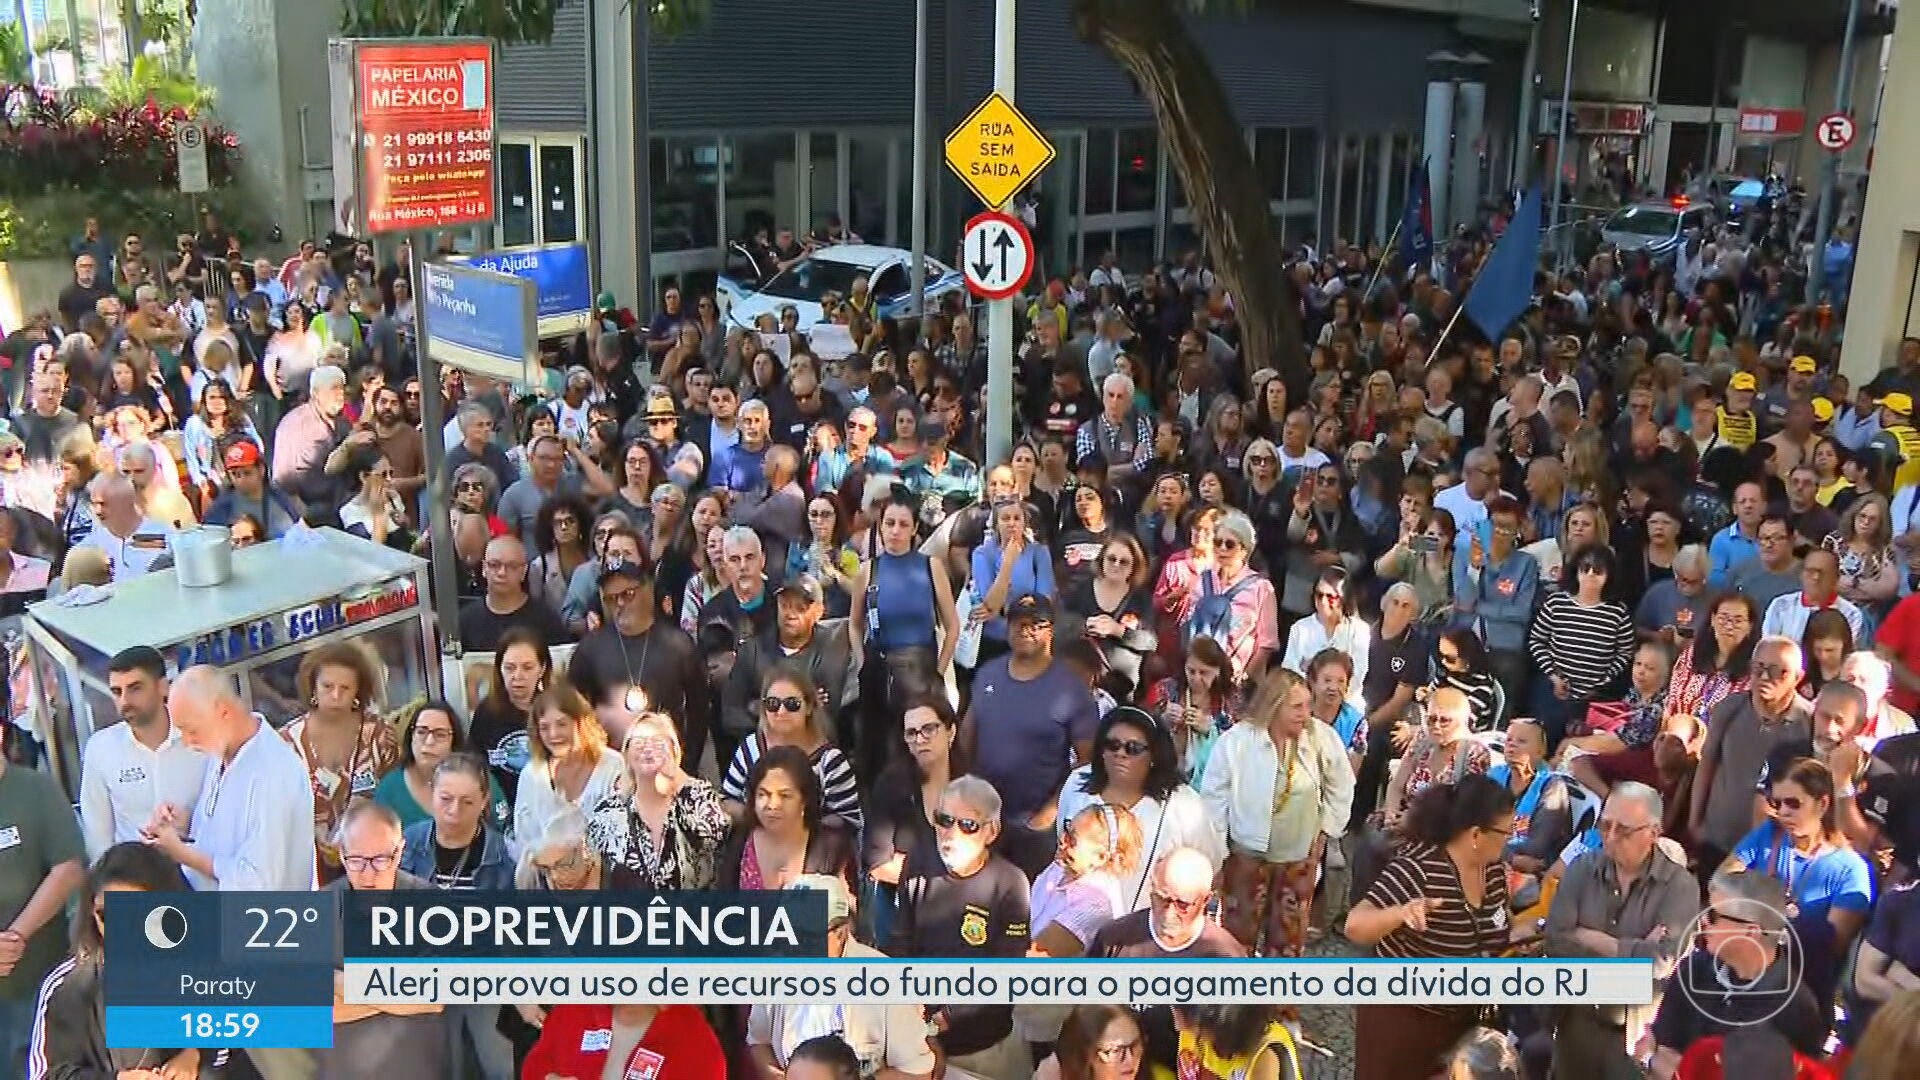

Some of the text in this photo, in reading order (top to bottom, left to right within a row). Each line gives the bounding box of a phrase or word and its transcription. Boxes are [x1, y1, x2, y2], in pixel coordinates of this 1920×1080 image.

[371, 67, 458, 83] PAPELARIA
[372, 86, 458, 107] MÉXICO
[980, 123, 1014, 136] RUA
[186, 130, 195, 143] E
[383, 134, 401, 147] 21
[980, 143, 1014, 156] SEM
[383, 154, 401, 168] 21
[501, 255, 538, 272] Ajuda
